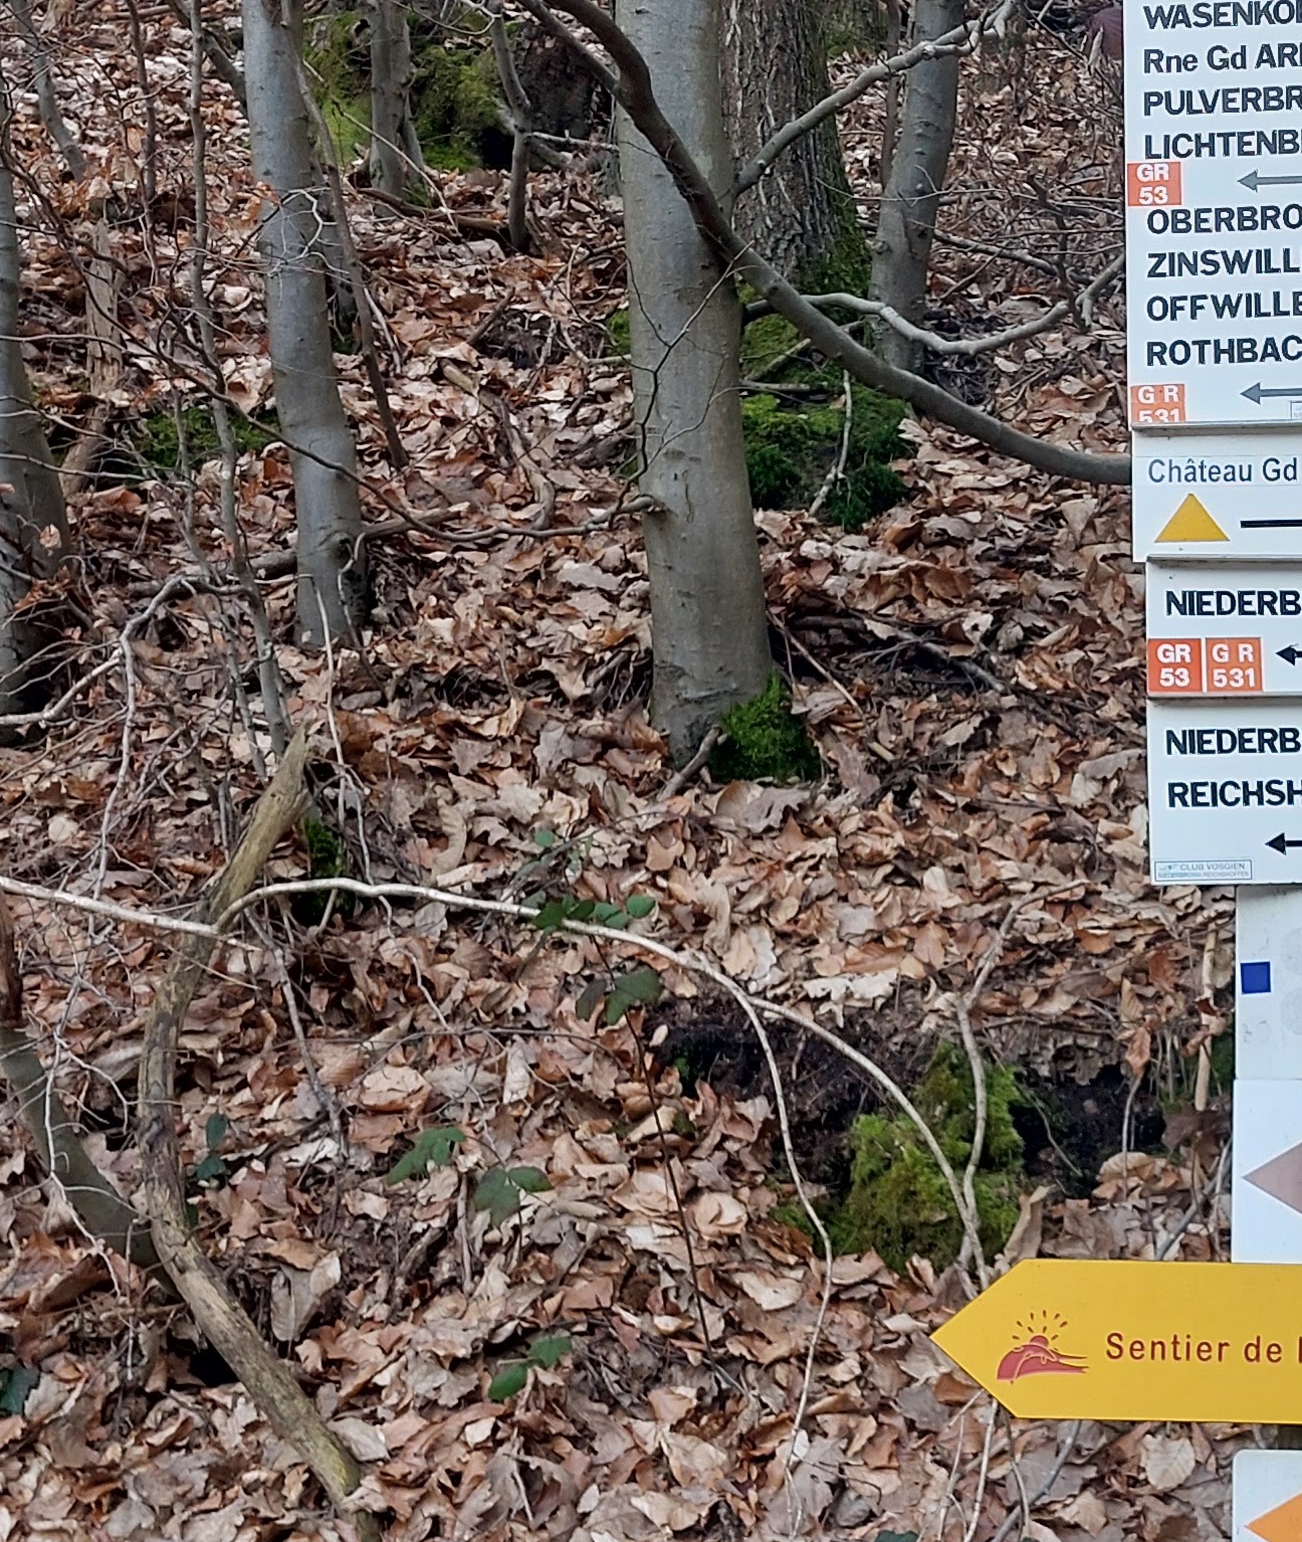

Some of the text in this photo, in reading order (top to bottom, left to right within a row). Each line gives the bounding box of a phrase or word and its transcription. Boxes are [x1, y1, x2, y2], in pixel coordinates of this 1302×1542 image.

[1143, 47, 1199, 74] Rne
[1206, 43, 1248, 71] Gd
[1135, 163, 1170, 183] GR
[1137, 186, 1169, 206] 53
[1138, 408, 1180, 424] 531
[1147, 456, 1253, 485] Château
[1261, 458, 1299, 482] Gd
[1156, 643, 1192, 663] GR
[1159, 667, 1256, 688] 53 531
[1104, 1330, 1231, 1363] Sentier
[1243, 1334, 1284, 1364] de
